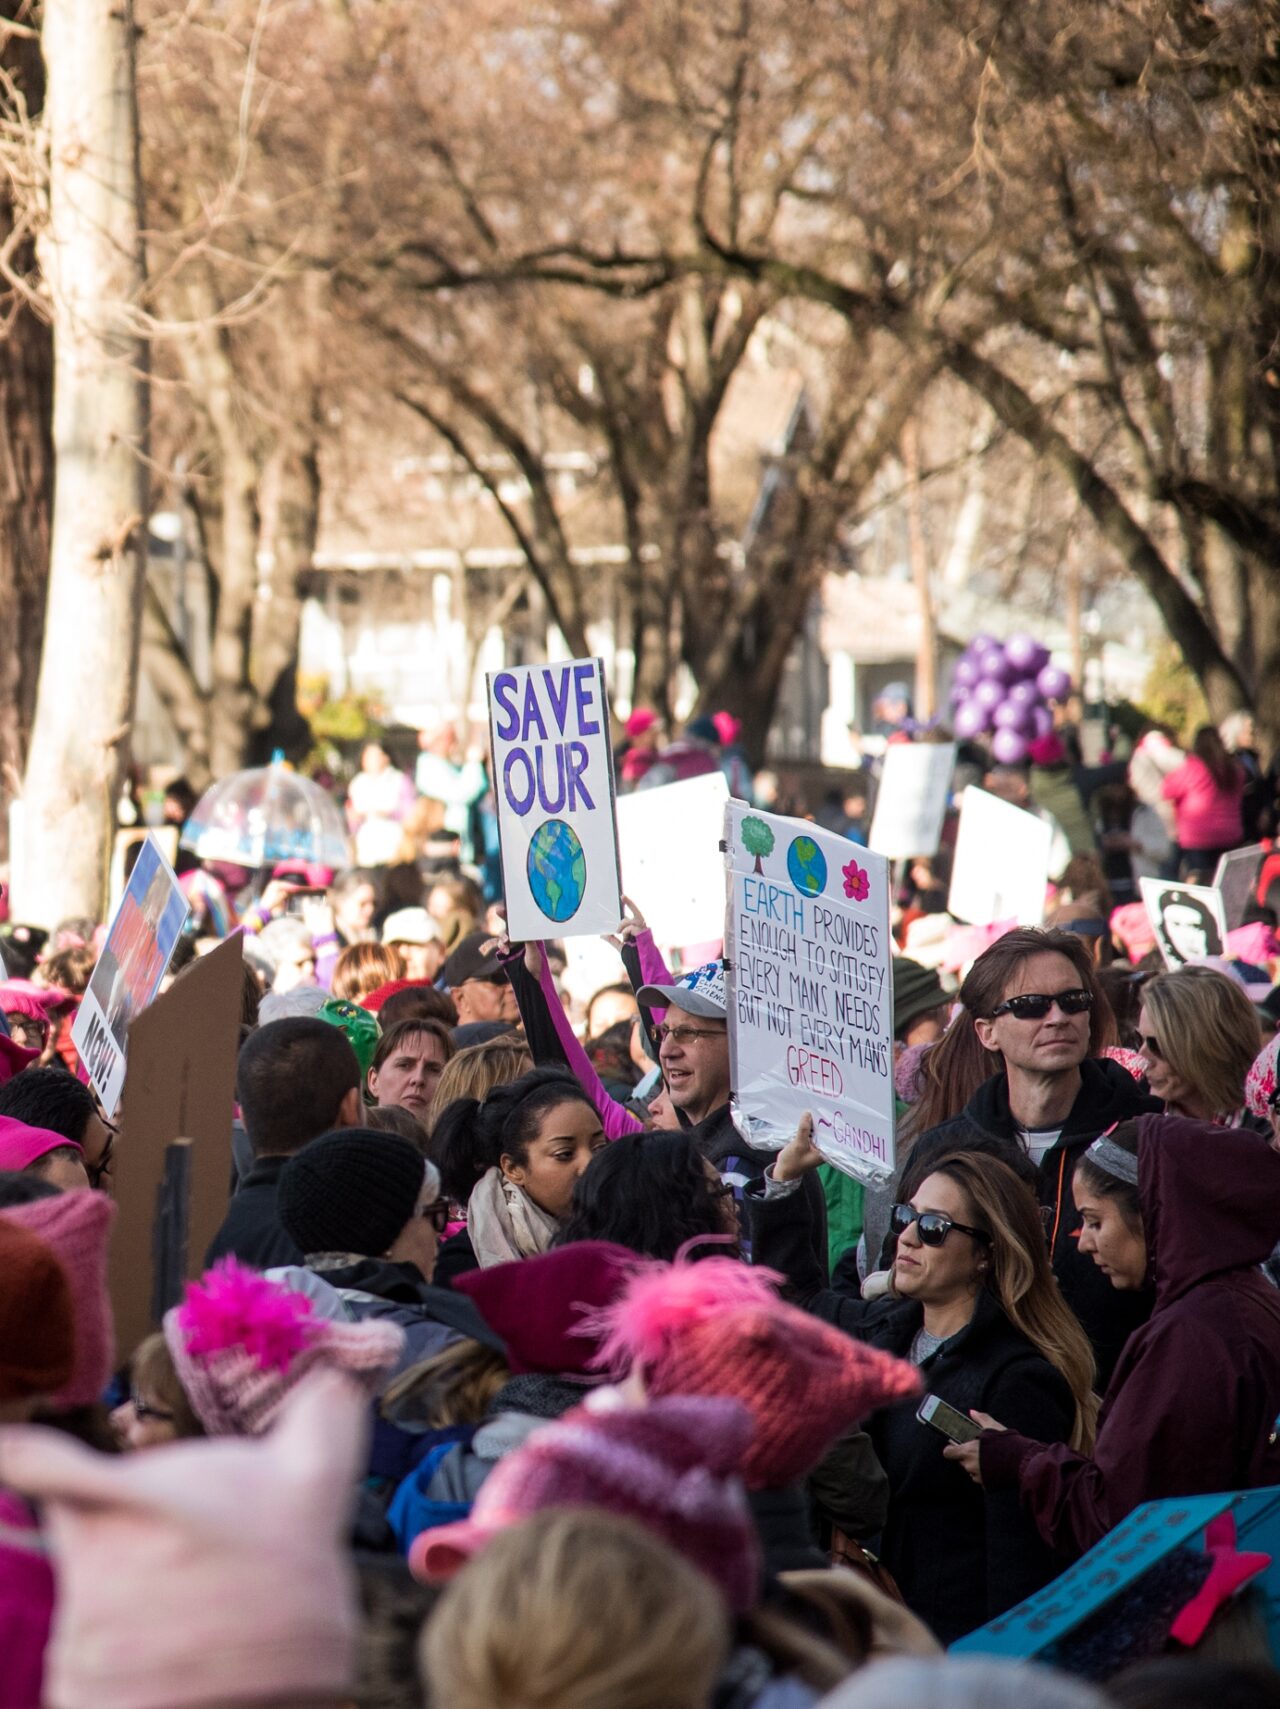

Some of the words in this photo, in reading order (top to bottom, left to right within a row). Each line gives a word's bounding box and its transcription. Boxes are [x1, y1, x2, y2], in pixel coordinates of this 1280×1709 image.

[493, 664, 600, 742] SAVE
[503, 741, 596, 817] OUR
[744, 877, 804, 935] EARTH
[813, 905, 879, 958] PROVIDES
[739, 951, 781, 998] EVERY
[789, 971, 828, 1017] MANS
[740, 914, 797, 966] ENOUGH
[802, 938, 826, 976] TO
[829, 950, 885, 1002] SATISFY
[80, 1011, 117, 1094] NOW!
[738, 989, 762, 1028] BUT
[767, 1001, 795, 1039] NOT
[801, 1013, 844, 1061] EVERY
[786, 1045, 843, 1098] GREED
